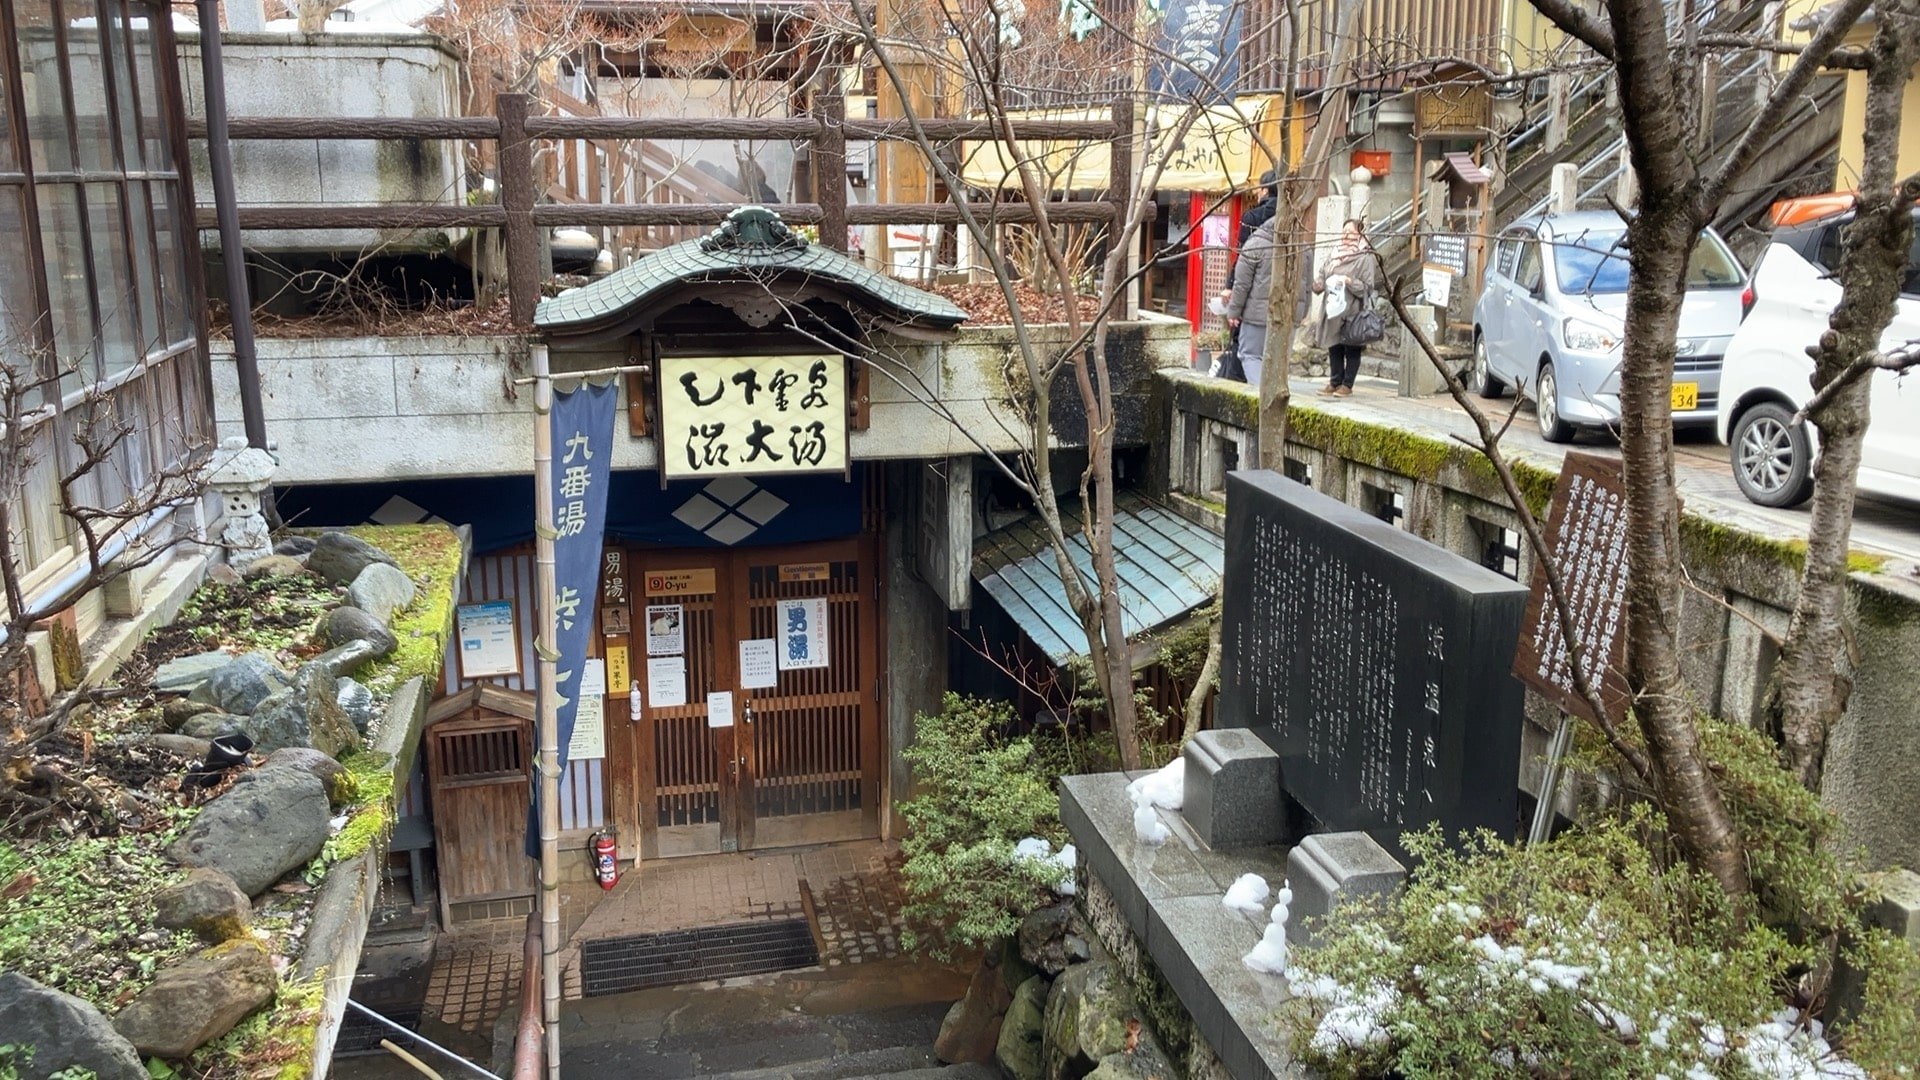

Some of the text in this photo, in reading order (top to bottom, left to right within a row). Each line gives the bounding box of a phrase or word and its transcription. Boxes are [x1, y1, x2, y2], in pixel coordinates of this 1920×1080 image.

[557, 431, 593, 541] 九番湯
[605, 551, 623, 598] 男湯
[652, 579, 687, 591] 9 O-yu
[787, 607, 809, 661] 男湯
[785, 660, 814, 668] 入口です
